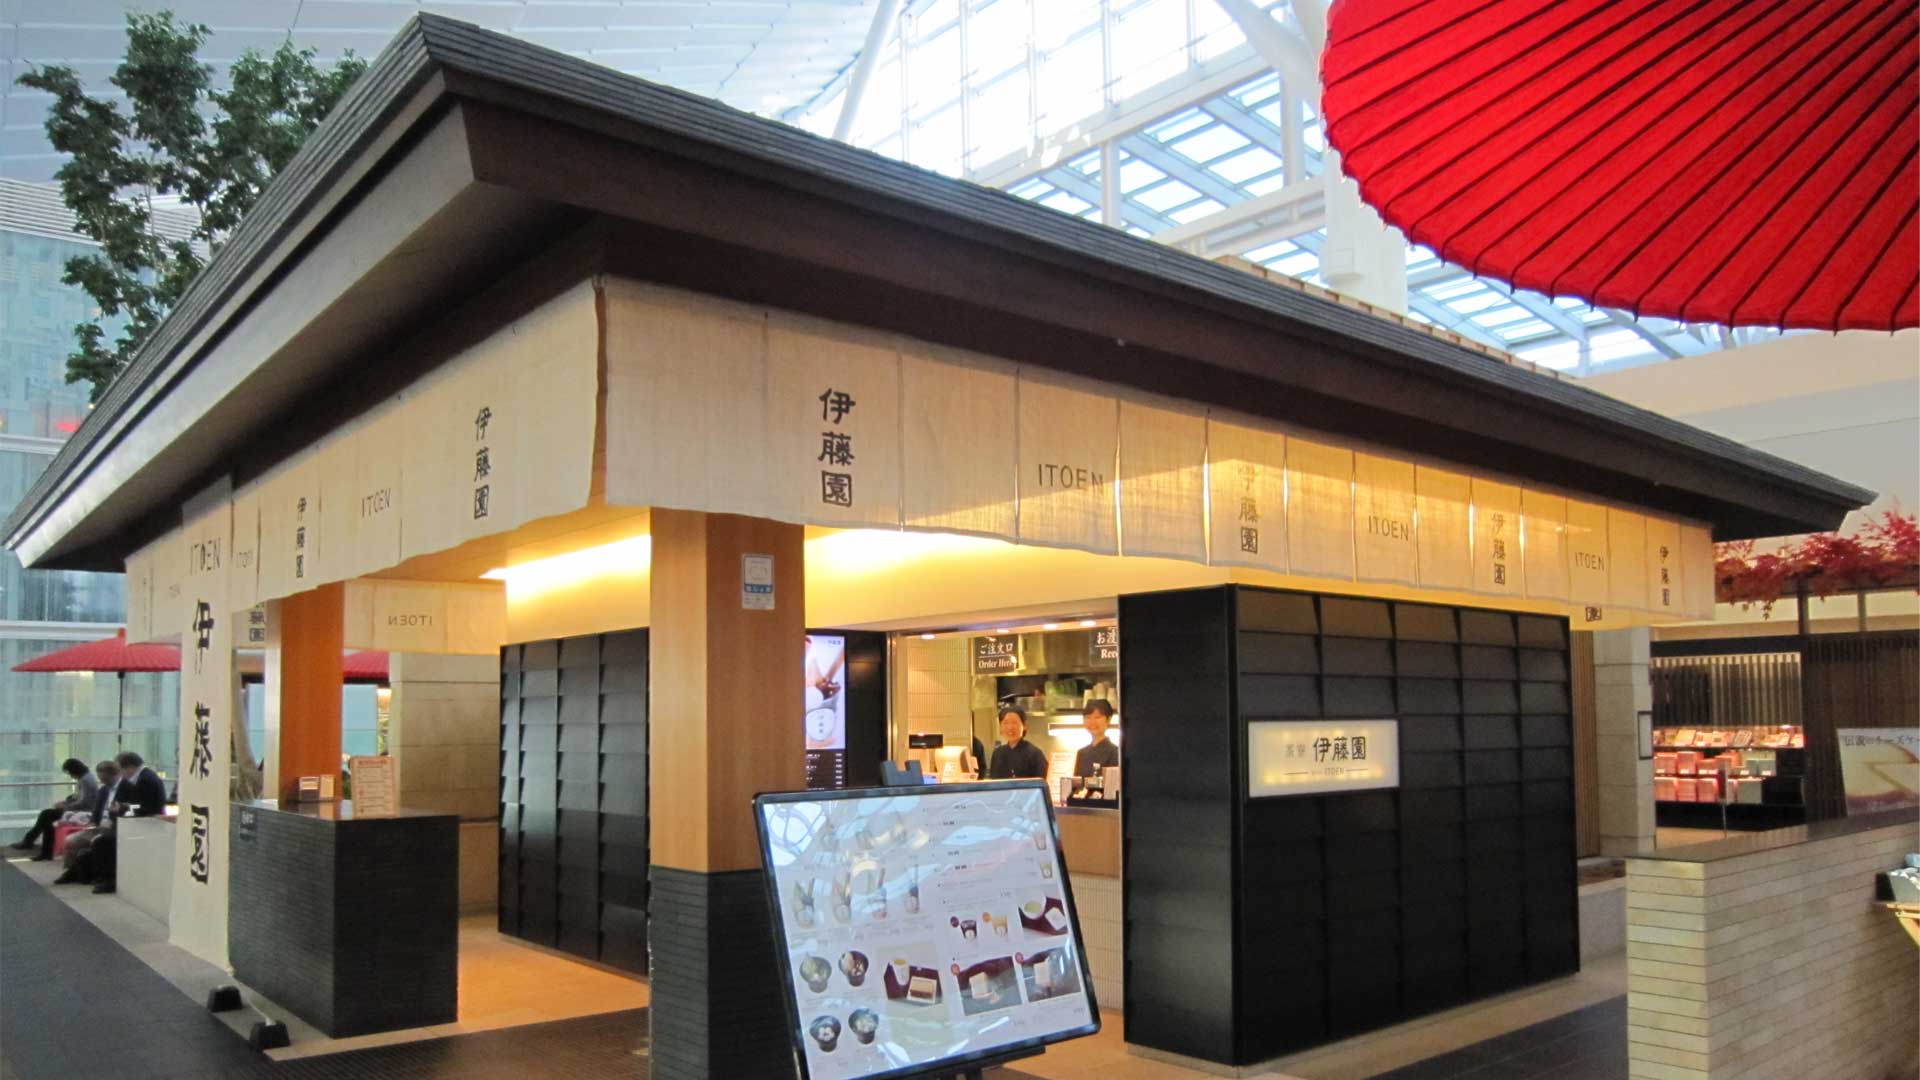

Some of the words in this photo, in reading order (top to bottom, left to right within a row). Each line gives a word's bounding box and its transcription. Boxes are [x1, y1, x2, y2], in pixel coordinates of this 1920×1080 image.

[474, 406, 492, 520] 伊藤園
[818, 387, 856, 508] 伊藤園
[1038, 463, 1104, 494] ITOEN
[361, 487, 391, 518] ITOEN
[1238, 464, 1260, 554] 伊藤園
[1367, 514, 1410, 541] ITOEN
[1492, 512, 1506, 585] 伊藤園
[1575, 551, 1605, 571] ITOEN
[978, 659, 998, 669] Order
[979, 642, 1014, 655] ご注文口
[190, 598, 215, 885] 伊藤園
[1312, 736, 1367, 763] 伊藤園
